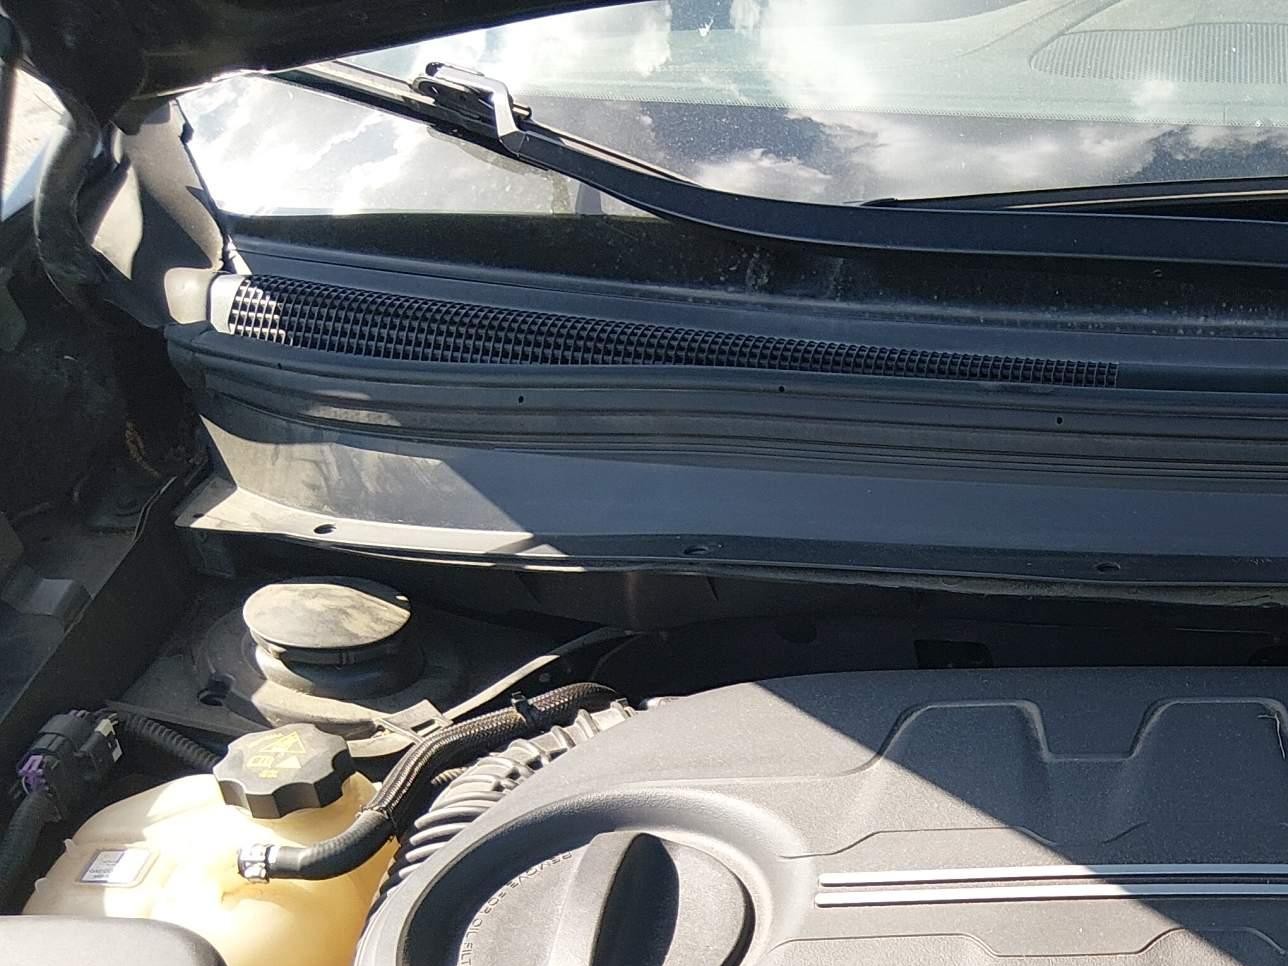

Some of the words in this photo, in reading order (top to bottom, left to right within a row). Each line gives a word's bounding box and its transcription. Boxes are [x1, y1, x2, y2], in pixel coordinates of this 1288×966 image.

[507, 850, 573, 889] REMOVE
[482, 891, 507, 915] FOR
[467, 917, 483, 938] OIL
